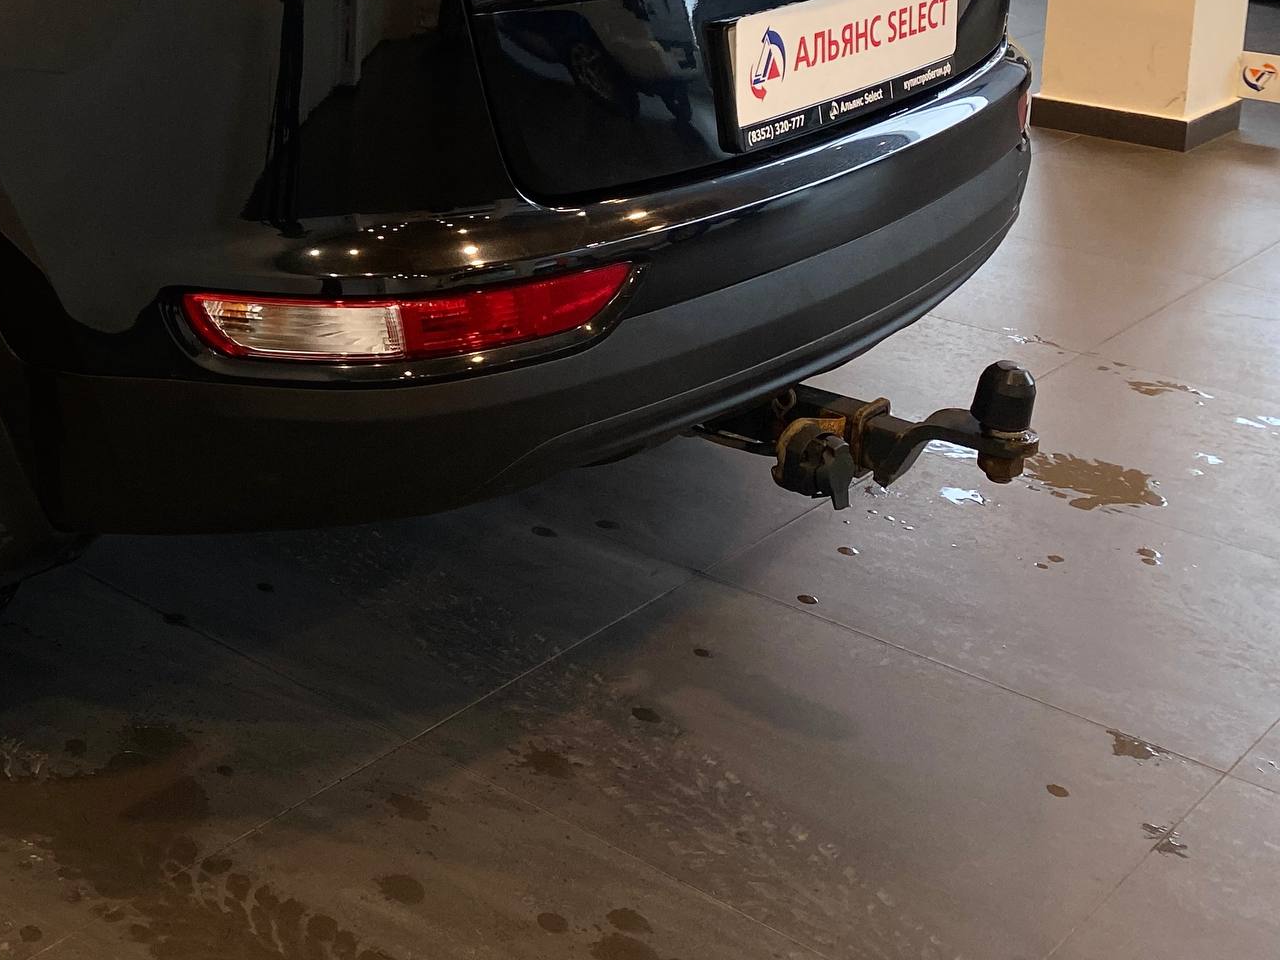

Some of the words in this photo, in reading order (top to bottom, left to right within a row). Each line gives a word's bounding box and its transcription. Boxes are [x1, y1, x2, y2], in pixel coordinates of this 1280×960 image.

[793, 14, 882, 72] АЛЬЯНС
[840, 96, 865, 113] Альянс
[864, 88, 884, 105] Select
[748, 123, 775, 147] (8352)
[775, 114, 805, 136] 320-777
